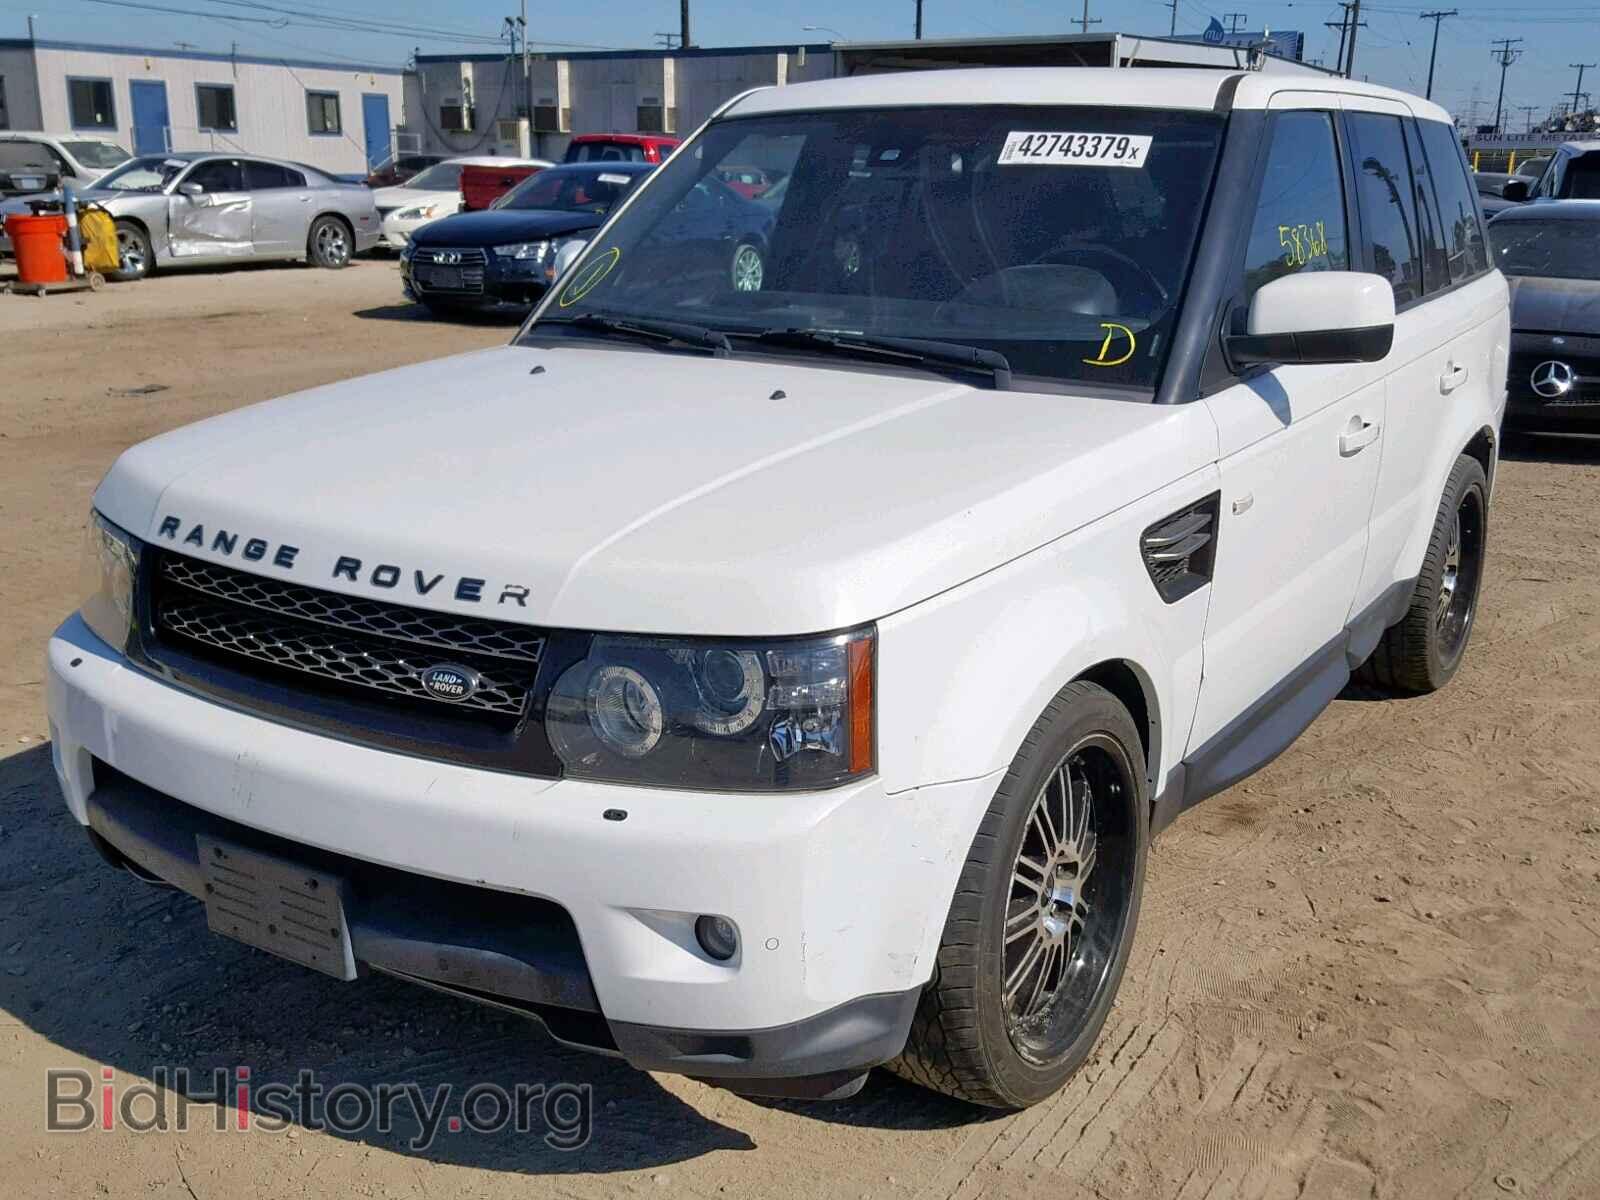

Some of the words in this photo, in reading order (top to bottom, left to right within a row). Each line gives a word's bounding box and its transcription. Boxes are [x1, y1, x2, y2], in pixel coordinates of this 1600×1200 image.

[1082, 322, 1136, 366] D
[157, 514, 300, 569] RANGE
[331, 555, 531, 608] ROVER
